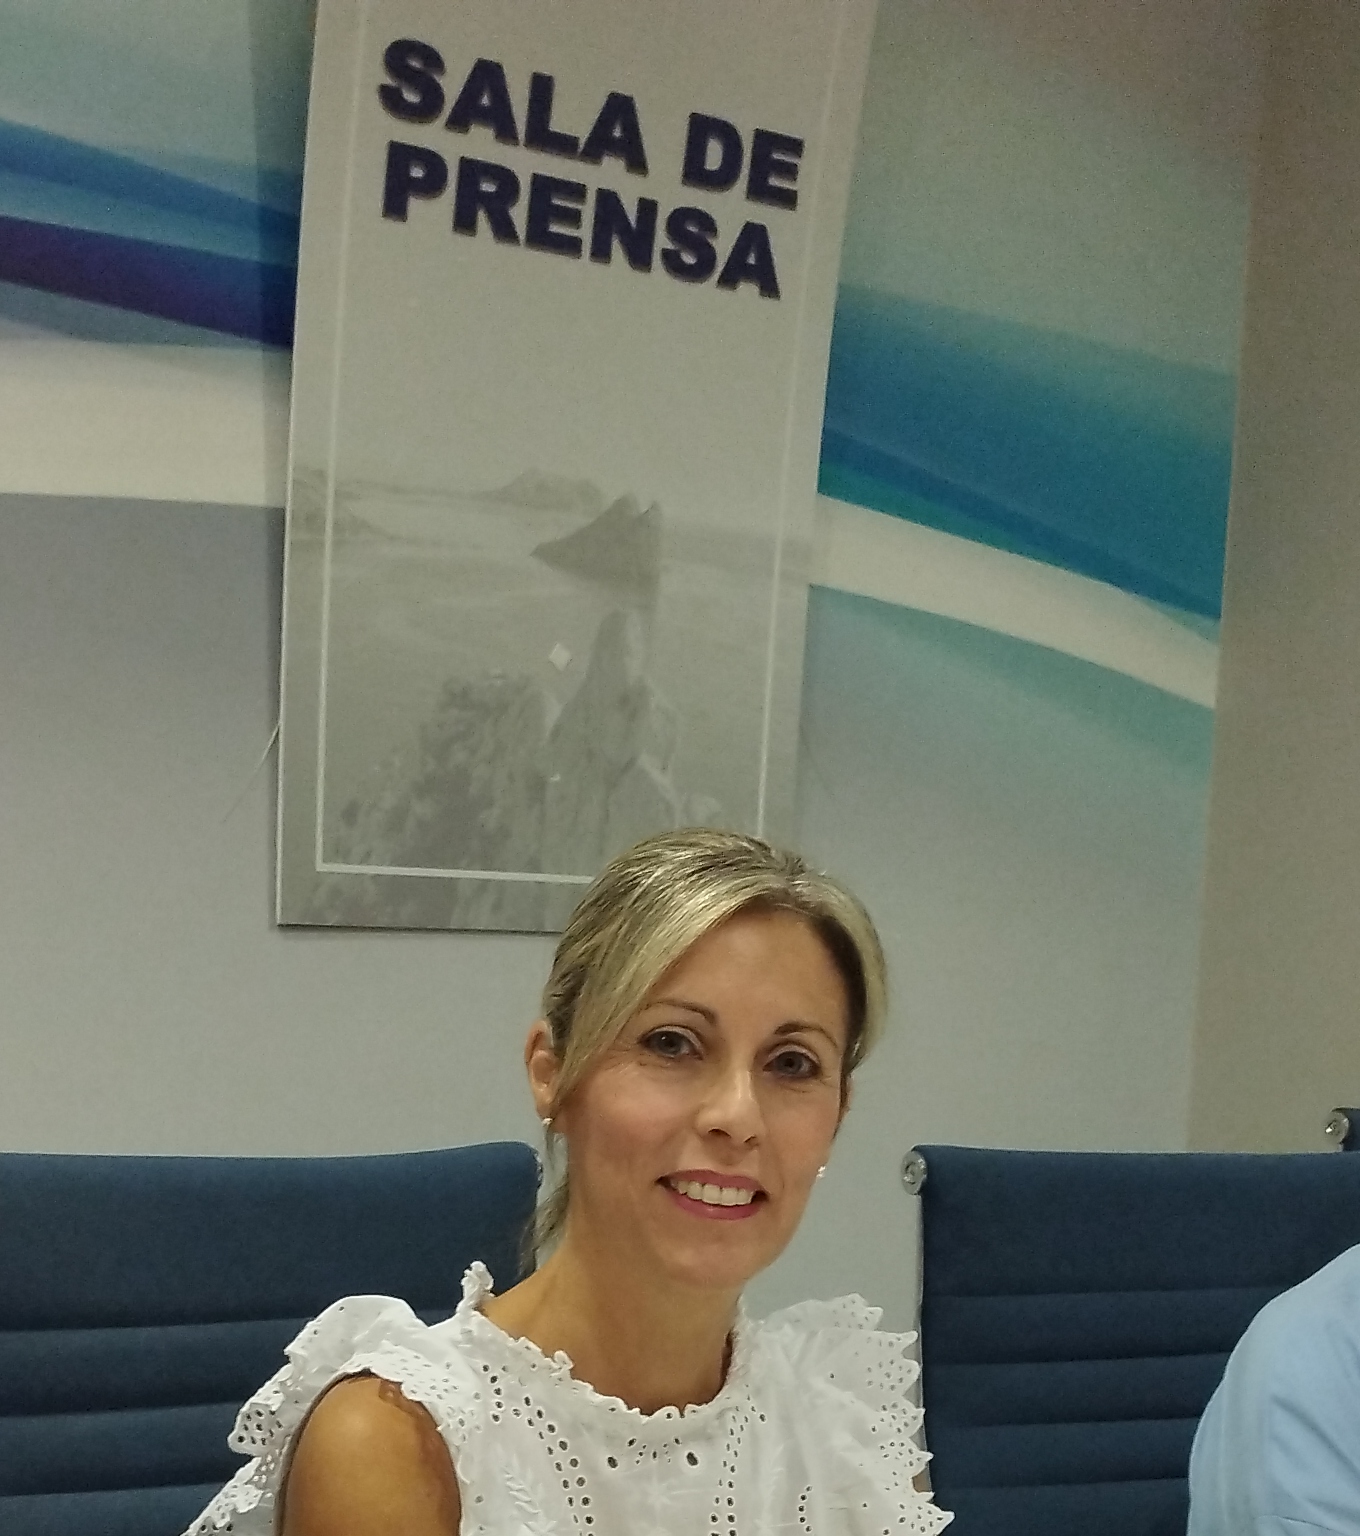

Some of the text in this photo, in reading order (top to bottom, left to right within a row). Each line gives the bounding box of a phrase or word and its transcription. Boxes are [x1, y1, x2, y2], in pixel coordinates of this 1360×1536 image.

[377, 38, 805, 211] SALA DE
[381, 139, 782, 301] PRENSA
